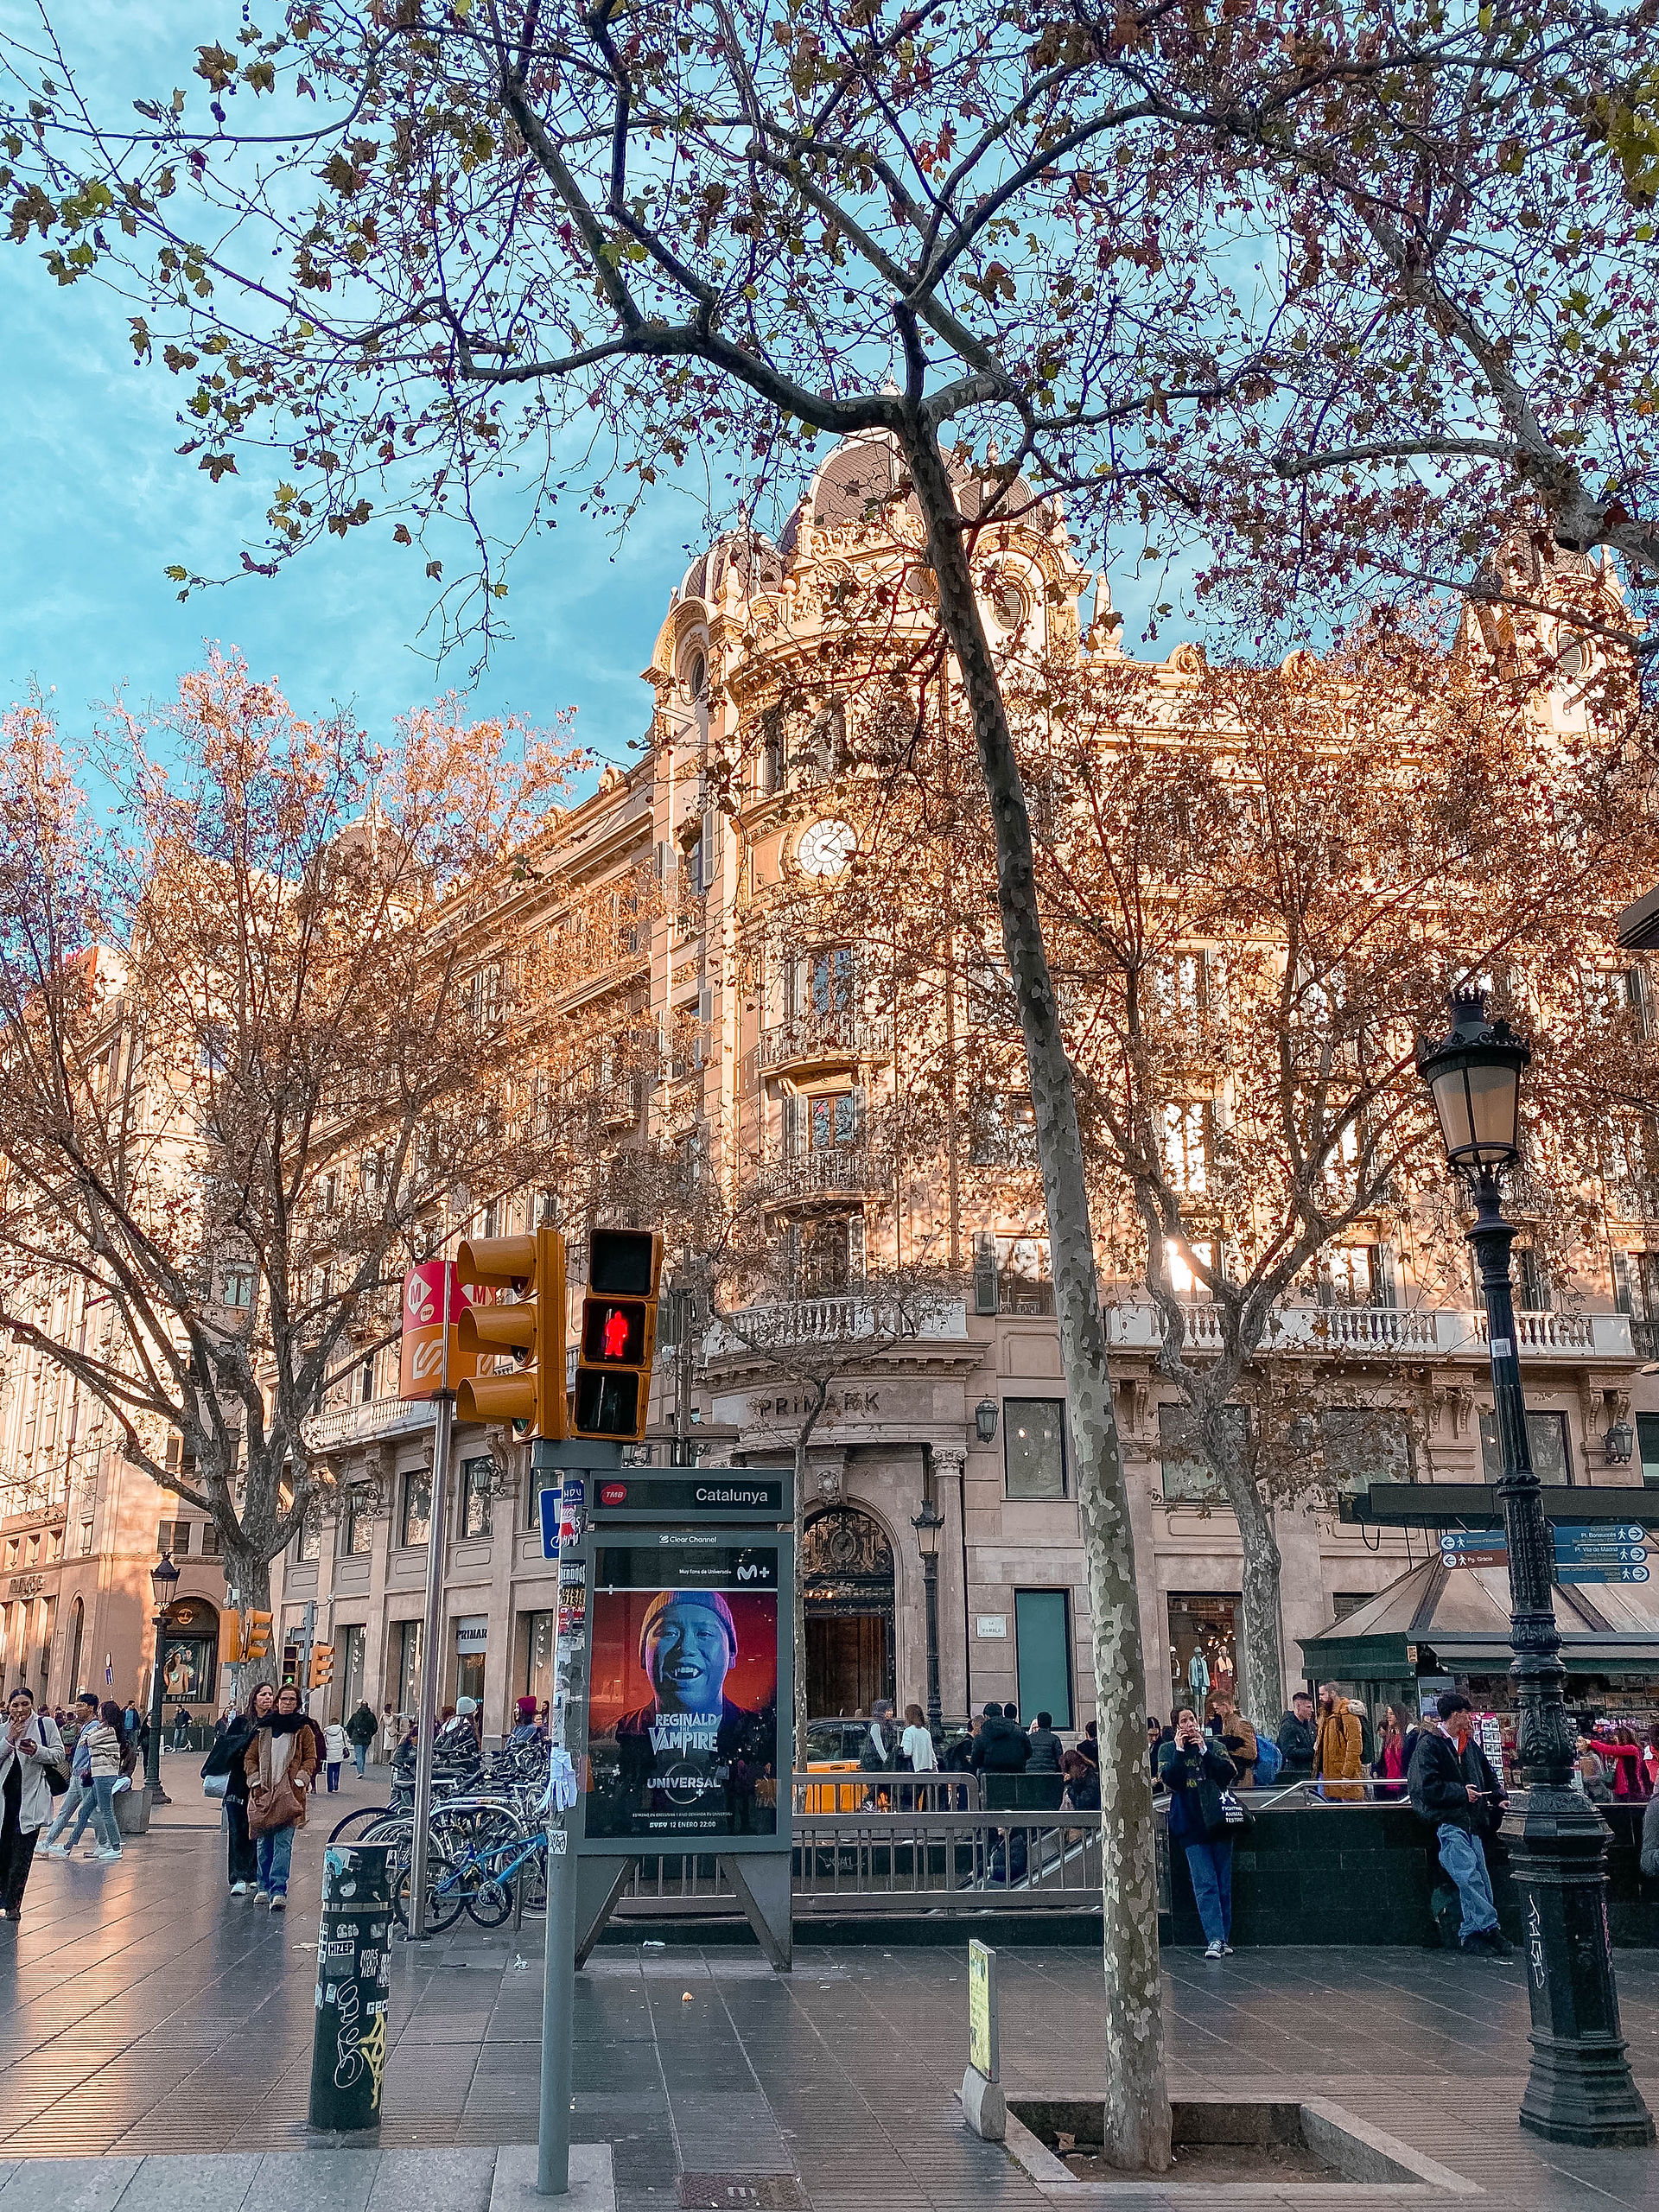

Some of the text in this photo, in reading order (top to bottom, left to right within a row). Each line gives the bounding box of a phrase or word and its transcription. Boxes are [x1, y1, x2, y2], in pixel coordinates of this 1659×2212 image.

[410, 1282, 422, 1305] M
[473, 1285, 486, 1306] M
[759, 1391, 880, 1417] PRIMARK
[606, 1491, 624, 1499] TMB
[696, 1488, 768, 1504] Catalunya
[655, 1713, 719, 1727] REGINALD
[647, 1727, 718, 1758] VAMPIRE
[646, 1777, 721, 1789] UNIVERSAL
[330, 1942, 353, 1954] HIZEP
